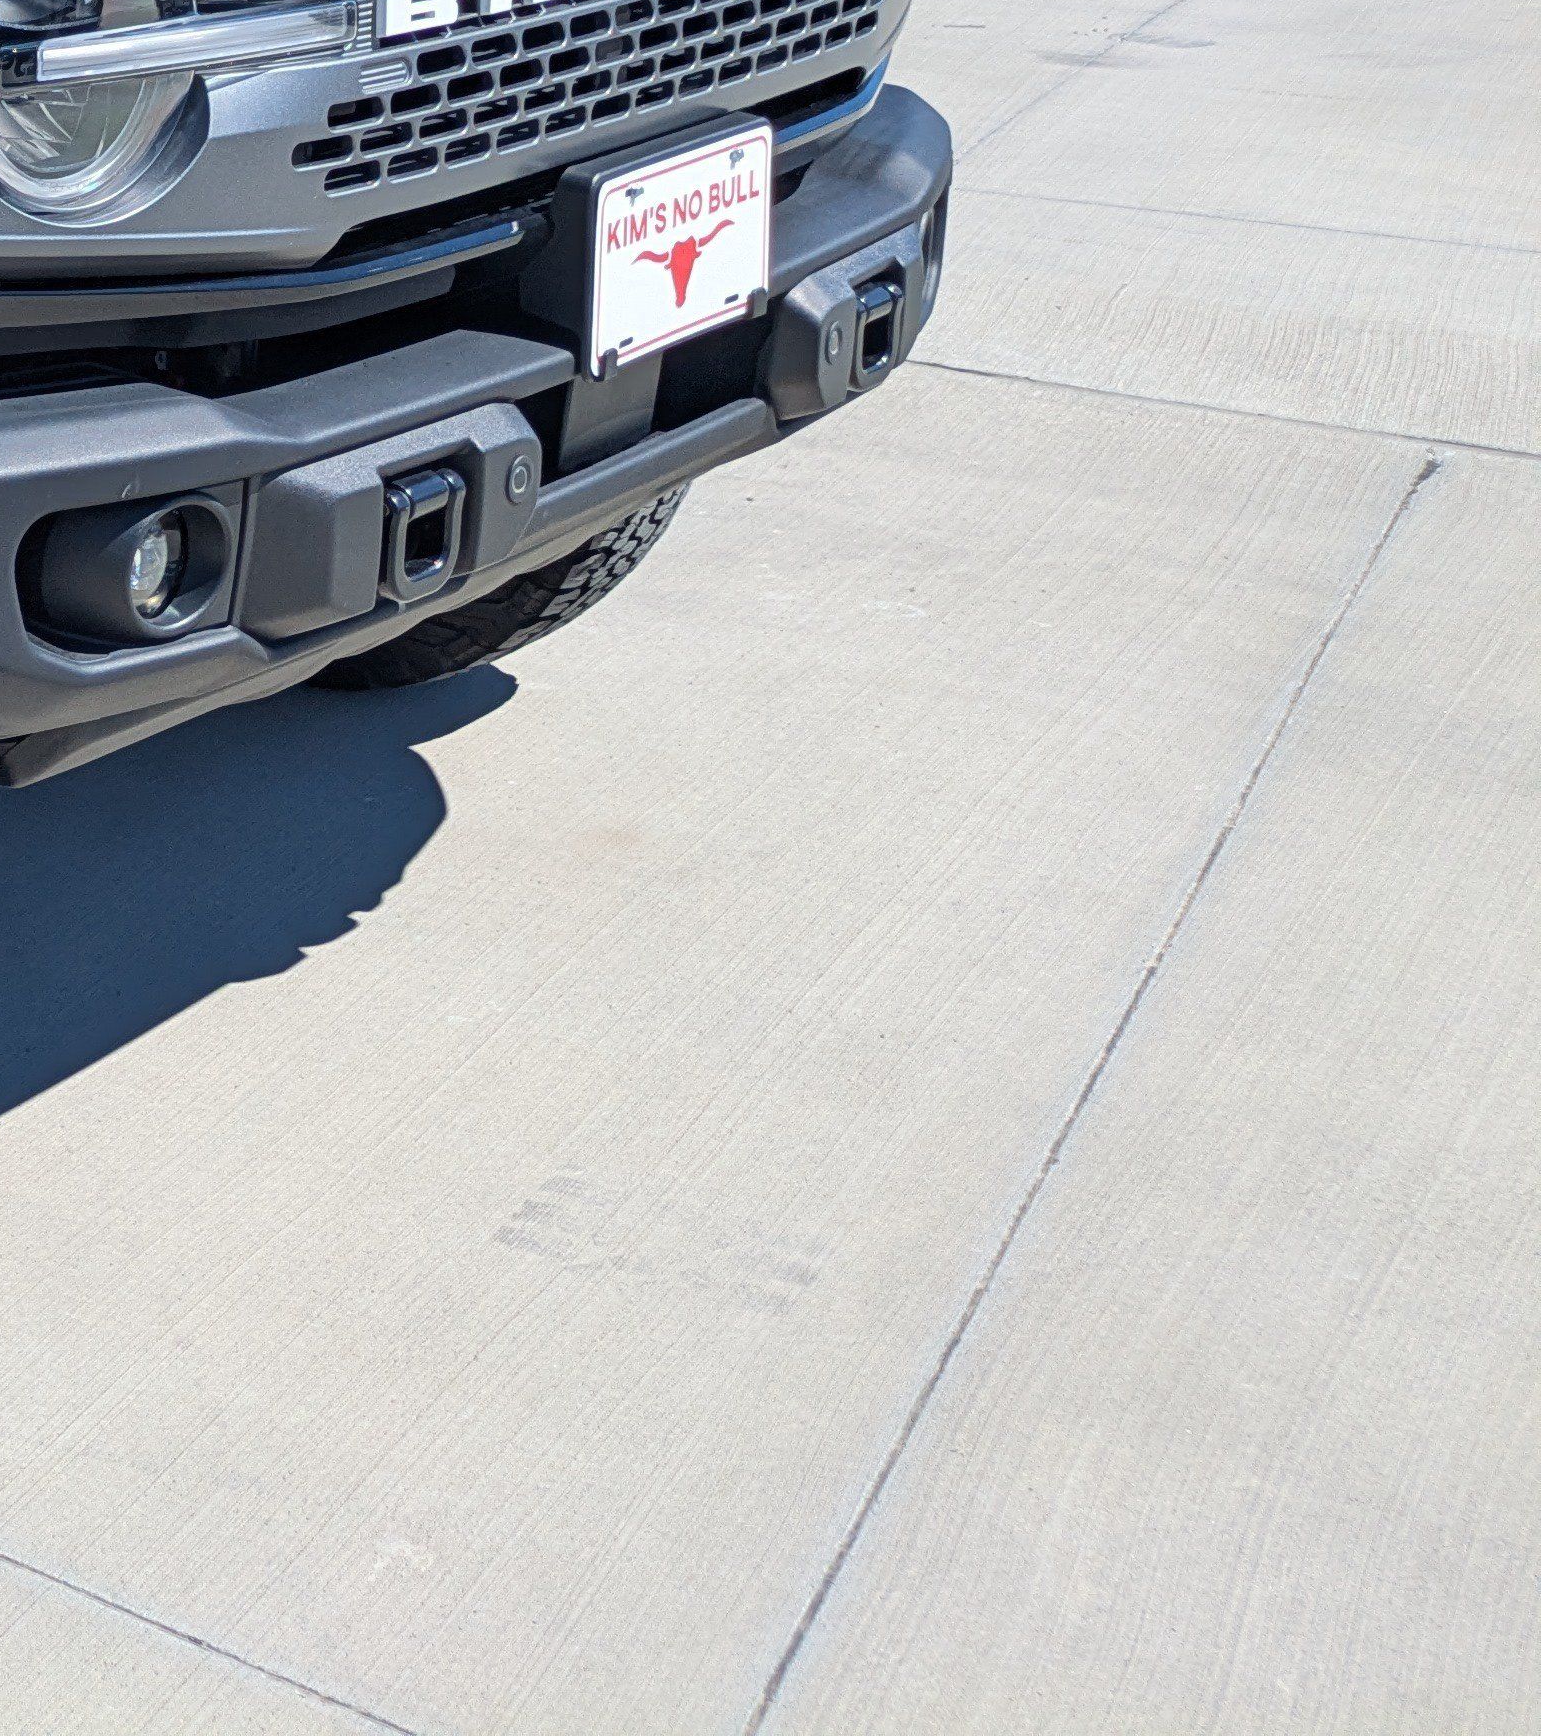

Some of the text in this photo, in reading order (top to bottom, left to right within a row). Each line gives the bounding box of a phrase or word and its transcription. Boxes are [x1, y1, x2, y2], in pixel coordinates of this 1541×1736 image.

[606, 170, 760, 254] KIM'S NO BULL
